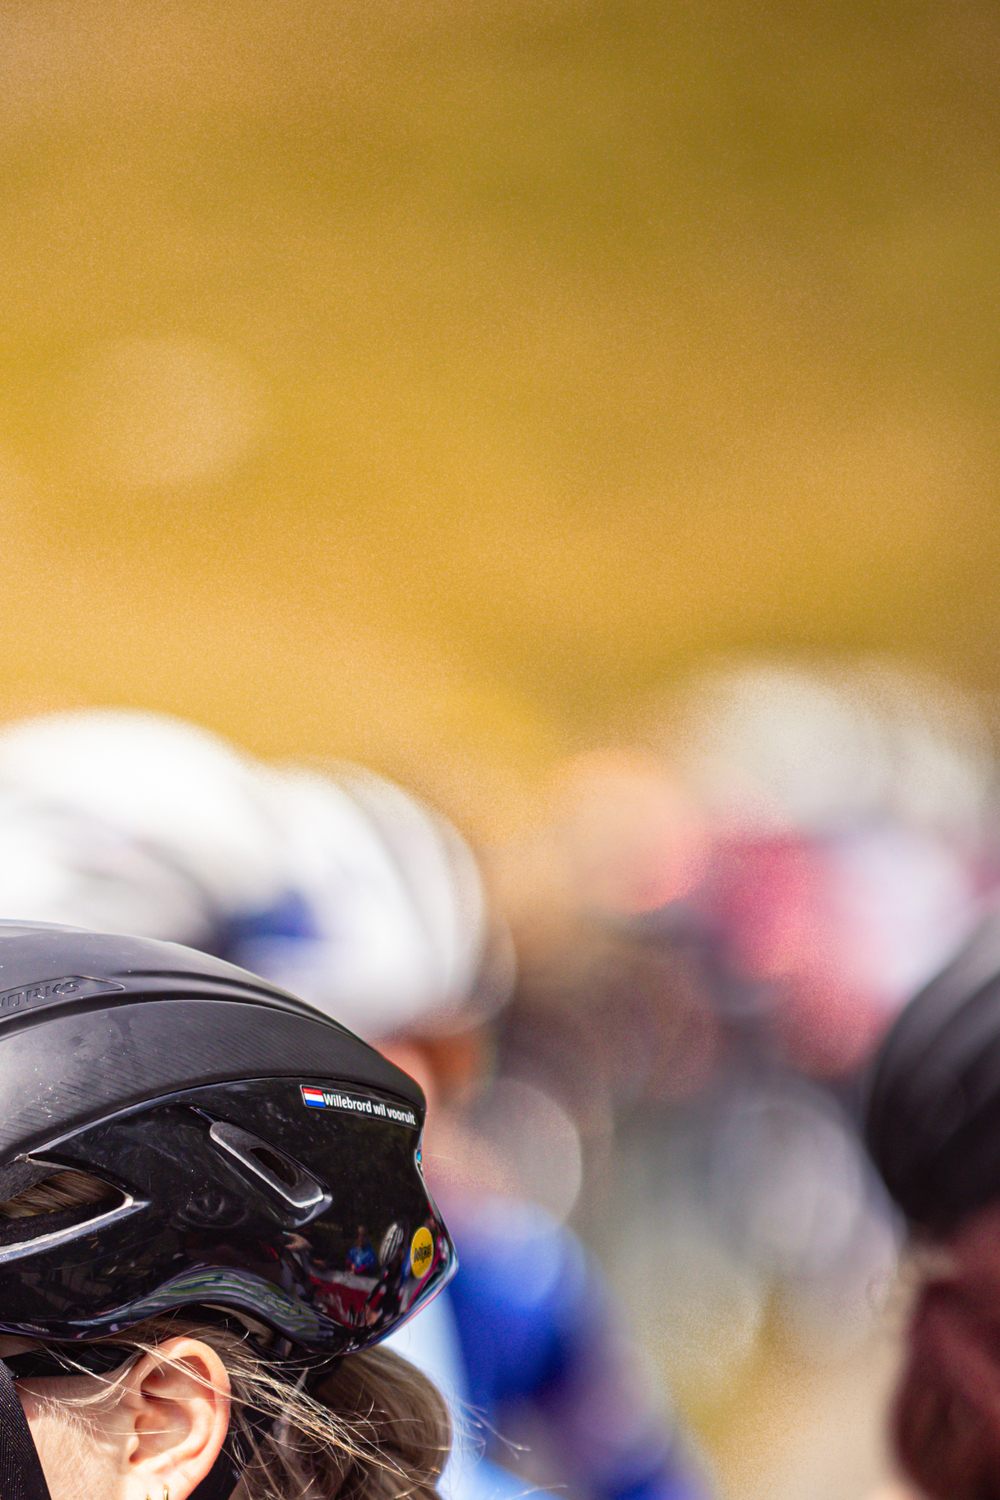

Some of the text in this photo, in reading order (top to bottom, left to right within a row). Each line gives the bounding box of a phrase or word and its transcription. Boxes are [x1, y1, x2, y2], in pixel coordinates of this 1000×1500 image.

[323, 1093, 417, 1126] Willebrord wil vooruit
